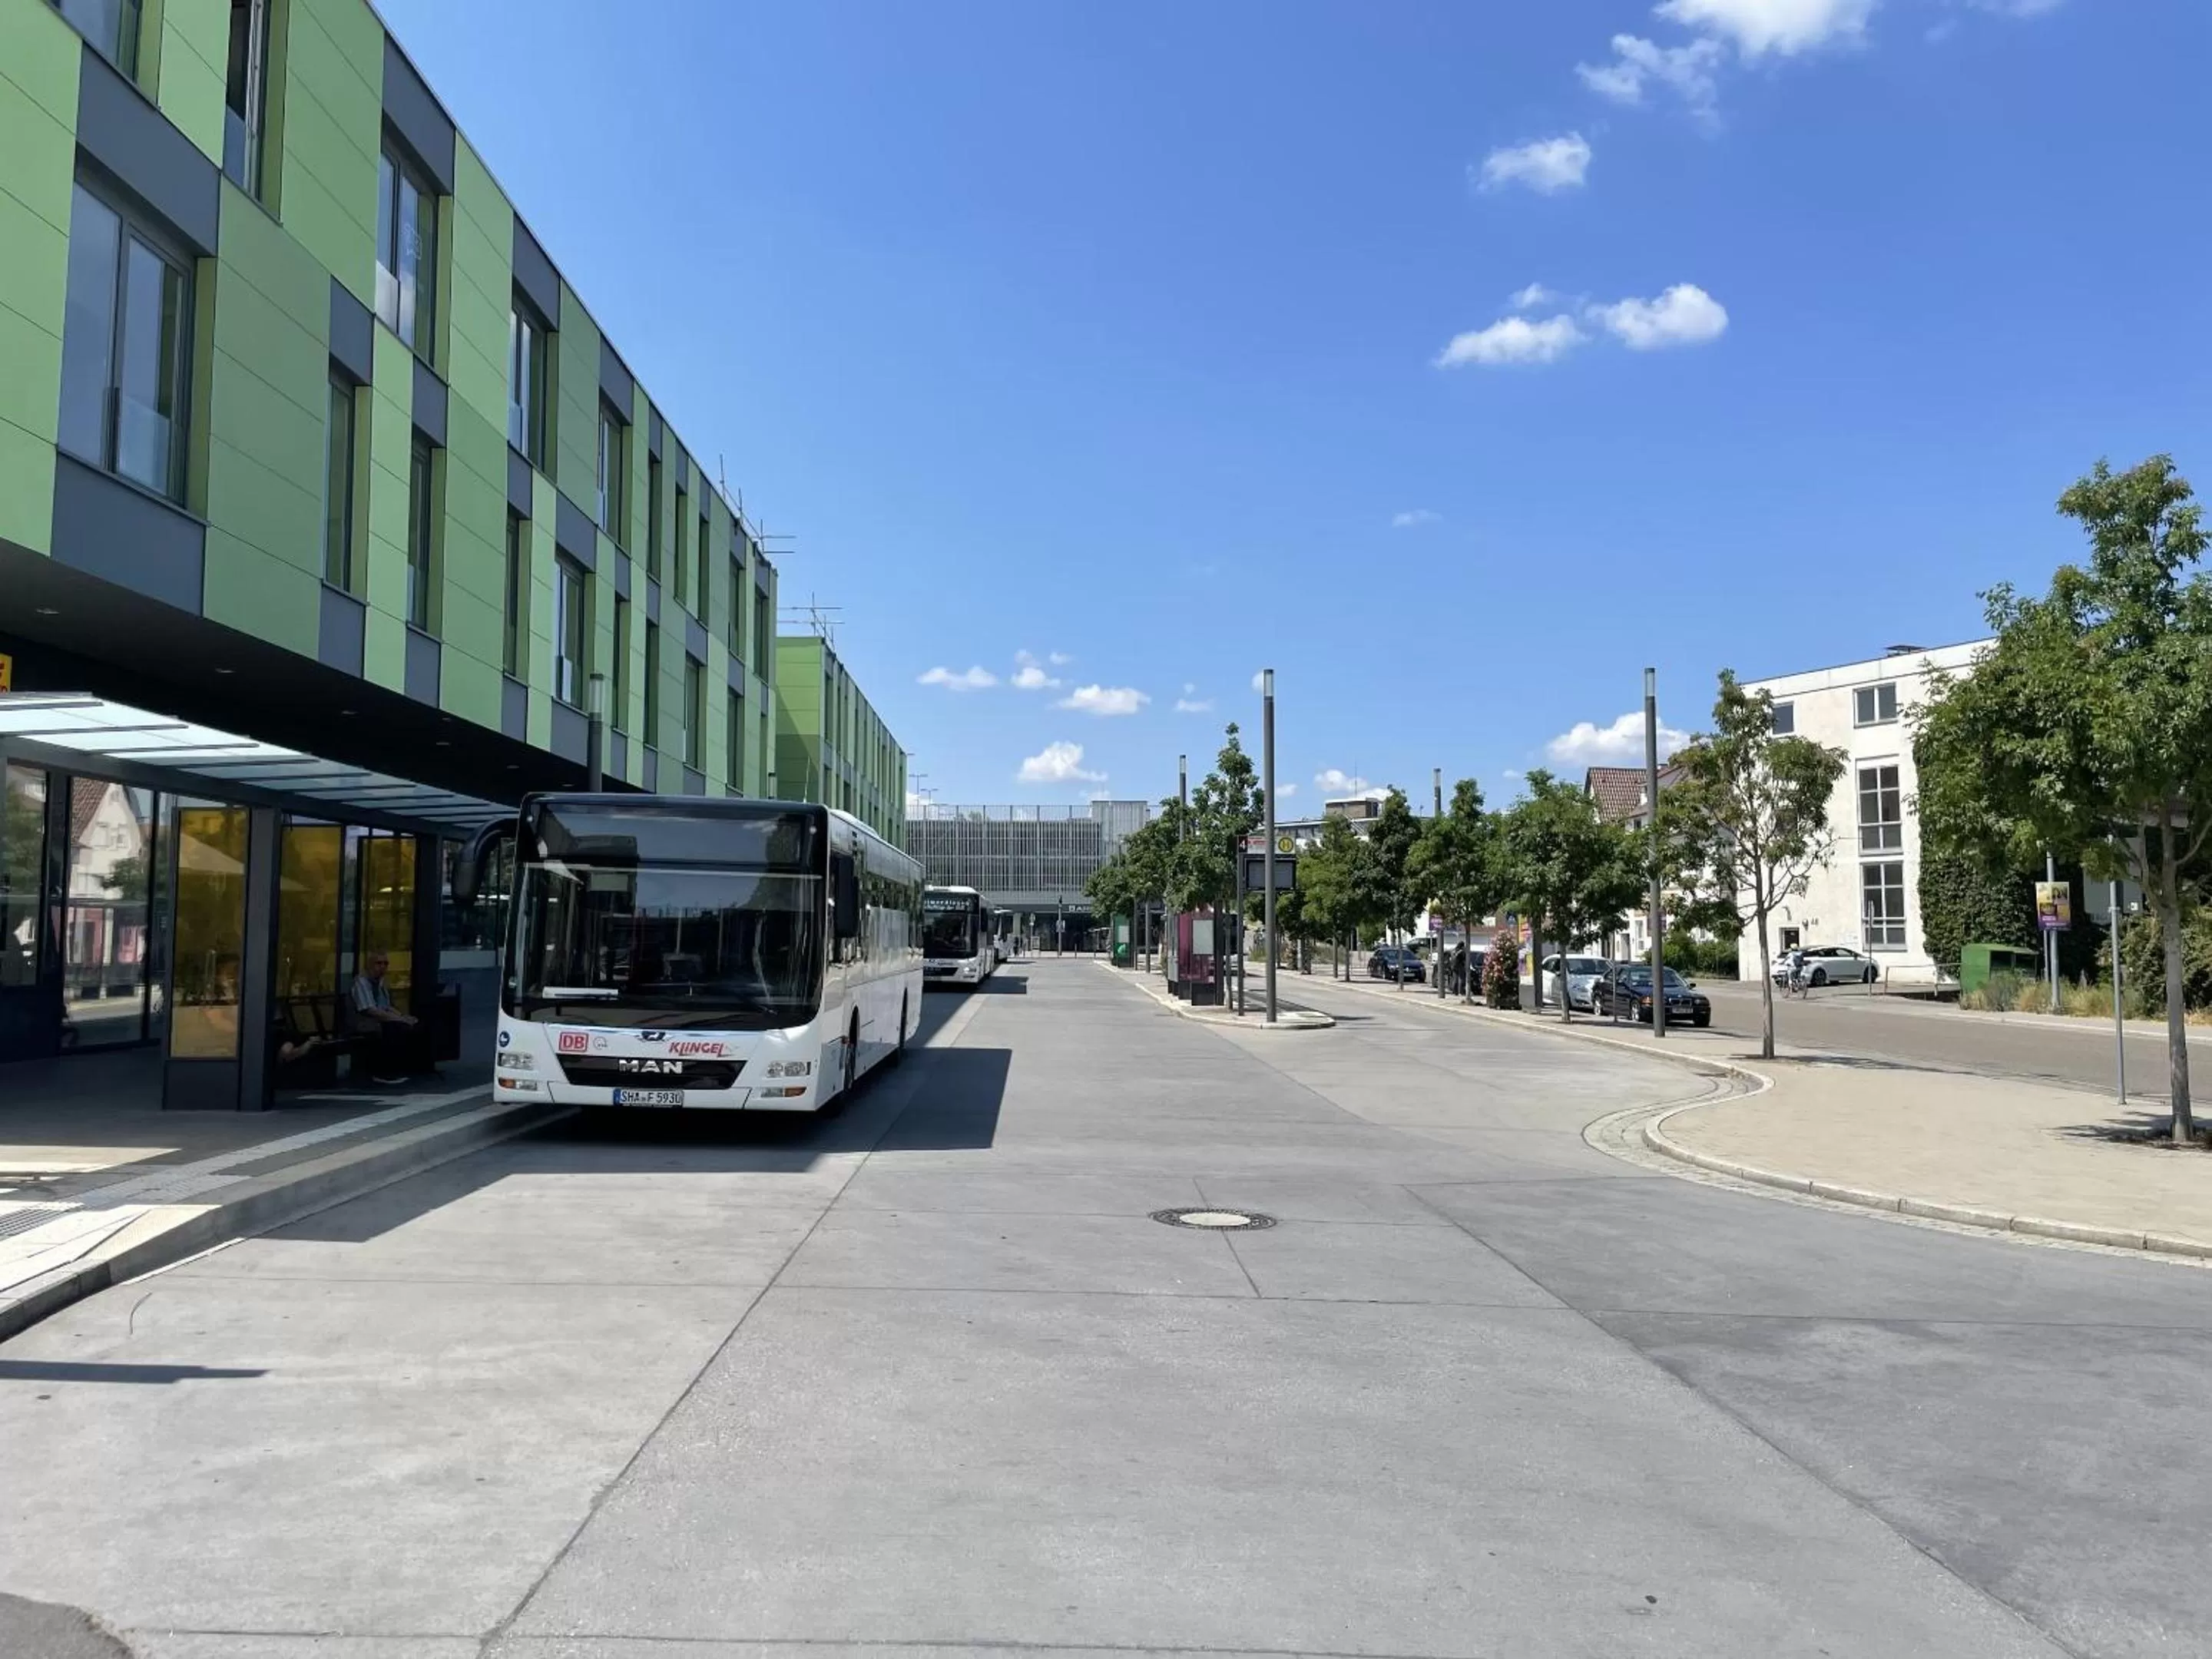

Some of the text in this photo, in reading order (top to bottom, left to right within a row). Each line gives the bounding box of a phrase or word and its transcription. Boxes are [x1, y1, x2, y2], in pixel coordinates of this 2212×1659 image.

[561, 1035, 585, 1050] DB
[668, 1041, 726, 1058] KLINGEL
[618, 1059, 683, 1075] MAN
